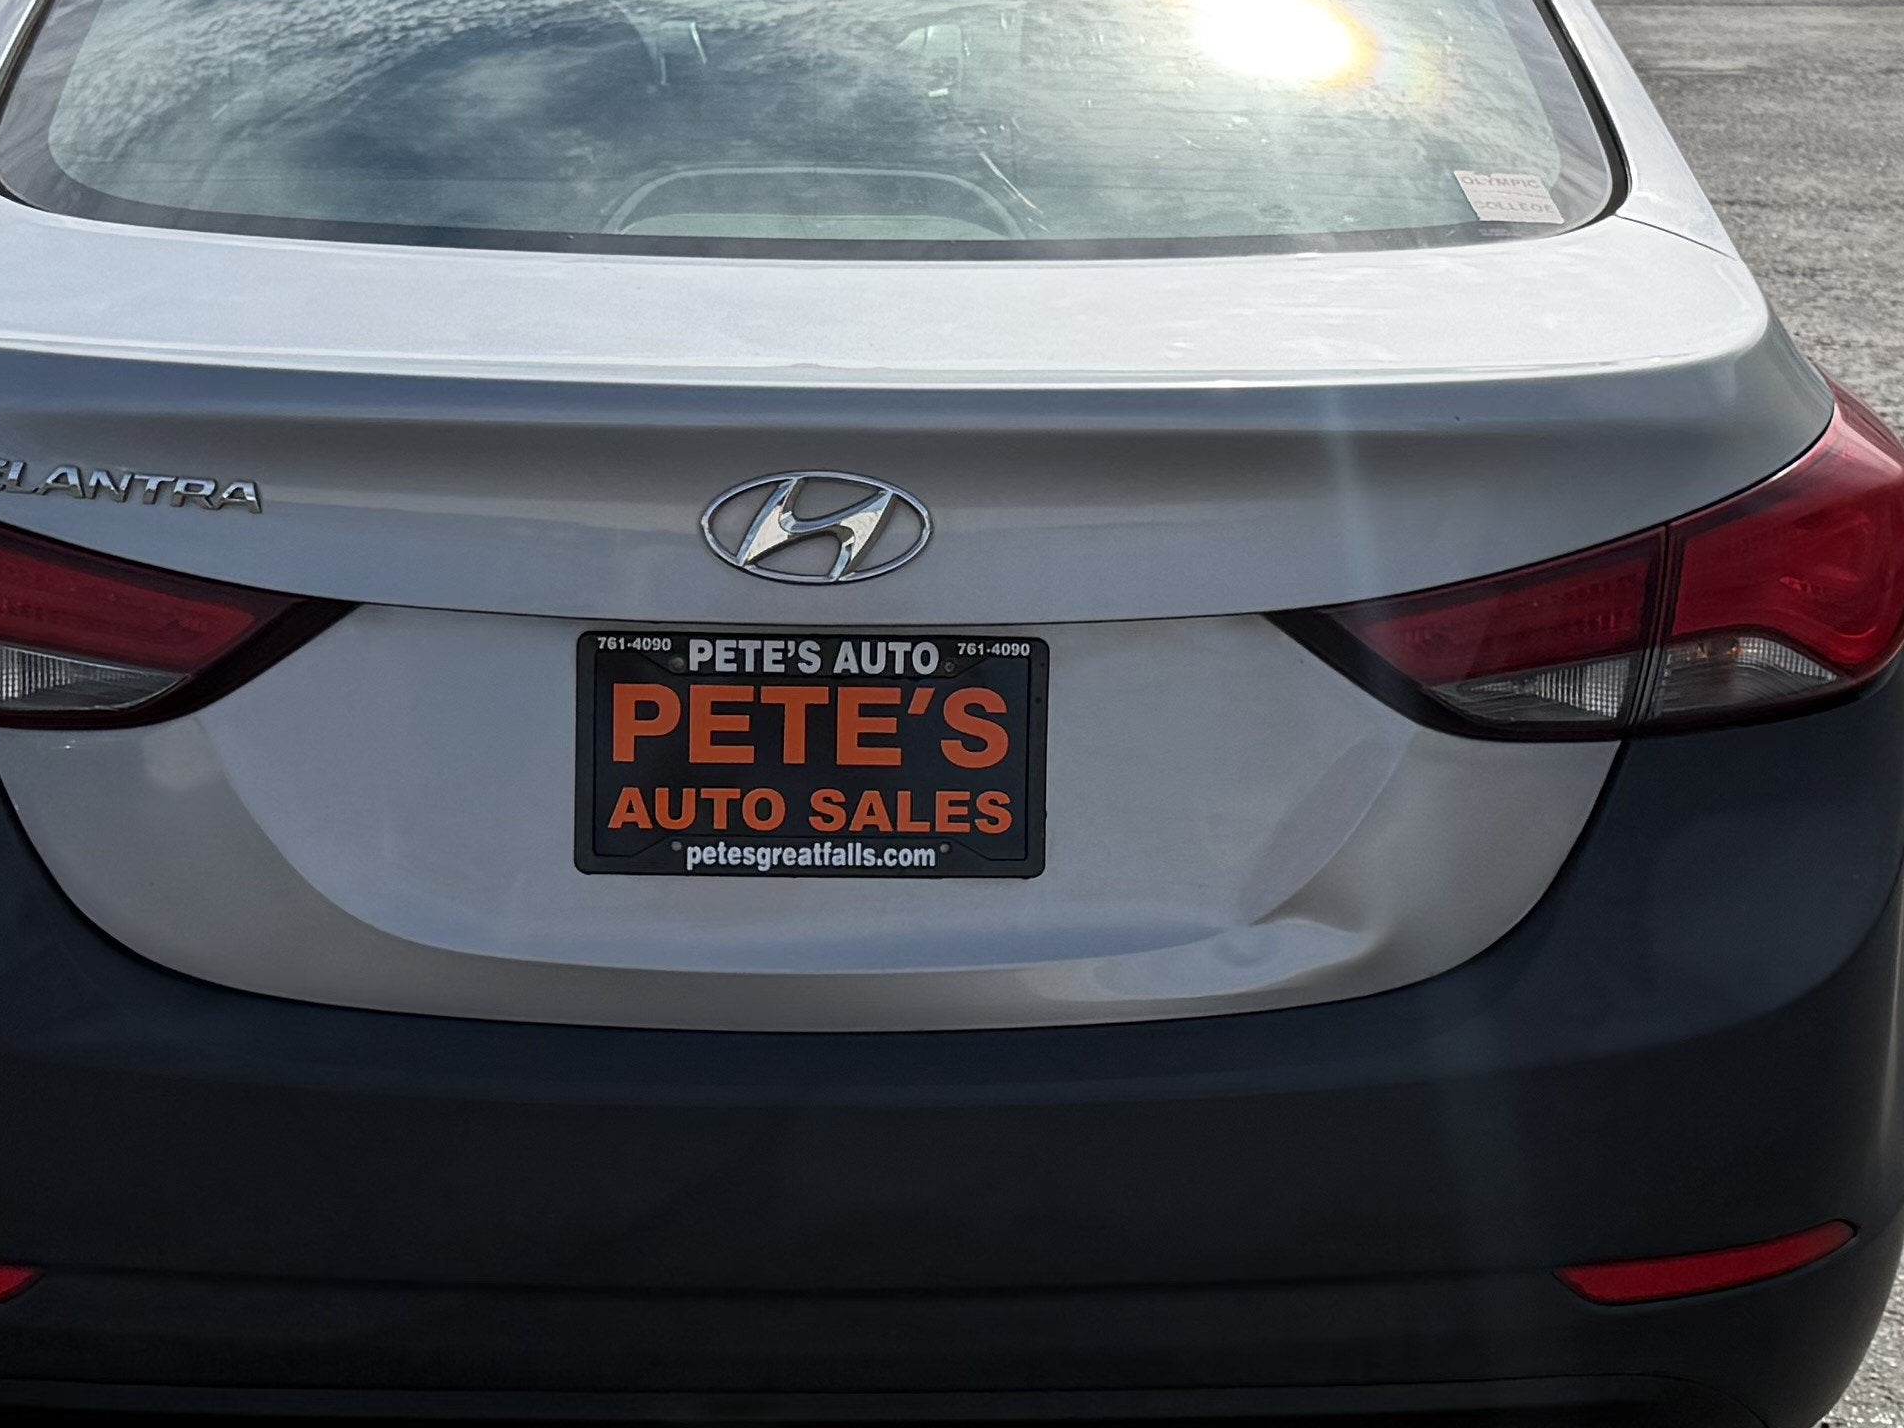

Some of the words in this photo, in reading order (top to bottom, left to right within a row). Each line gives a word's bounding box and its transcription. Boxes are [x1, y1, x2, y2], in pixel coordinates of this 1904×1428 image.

[1462, 175, 1541, 189] OLYMPIC
[689, 639, 822, 674] PETE'S
[833, 641, 940, 675] AUTO
[613, 683, 1010, 769] PETE'S
[608, 787, 787, 832] AUTO
[809, 789, 1014, 835] SALES
[686, 841, 937, 872] petesgreatfalls.com
